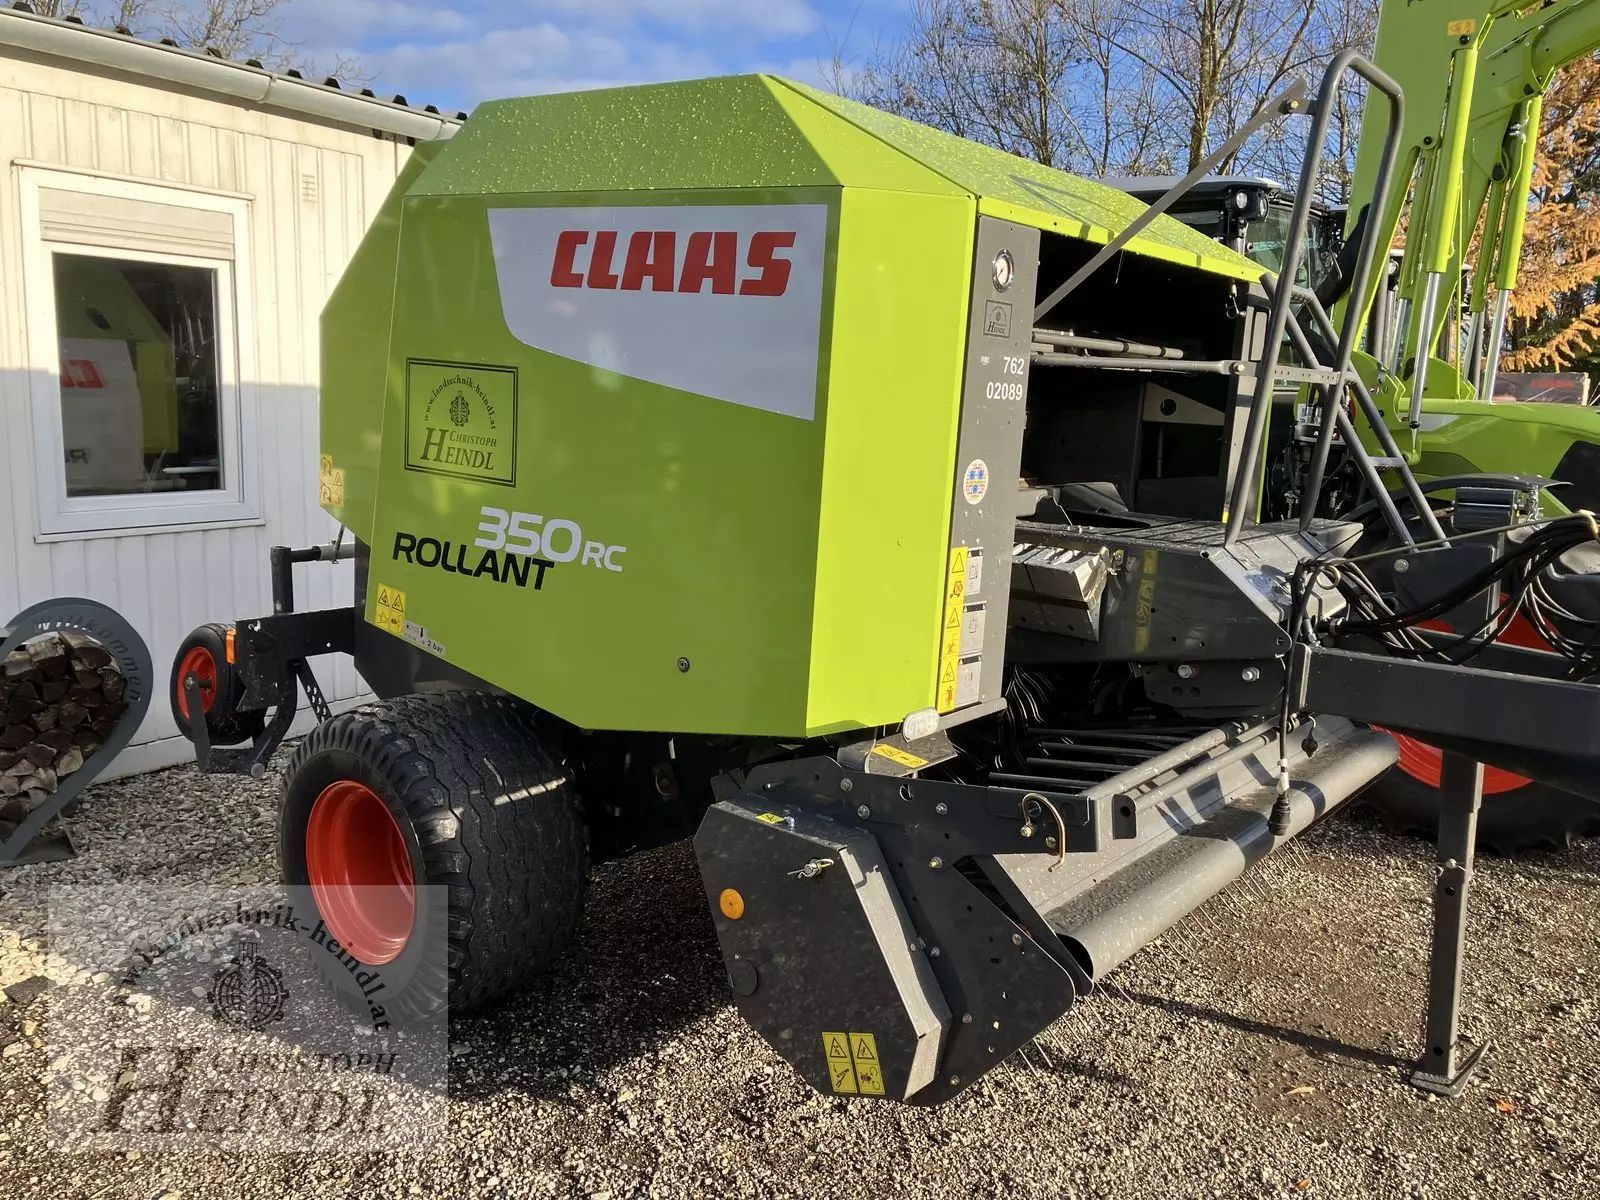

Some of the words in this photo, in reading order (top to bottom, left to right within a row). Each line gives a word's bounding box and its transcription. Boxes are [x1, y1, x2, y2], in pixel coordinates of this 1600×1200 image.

[550, 230, 796, 297] CLAAS
[1003, 356, 1025, 375] 762
[986, 381, 1023, 401] 02089
[392, 532, 554, 591] ROLLANT
[432, 642, 444, 653] bar
